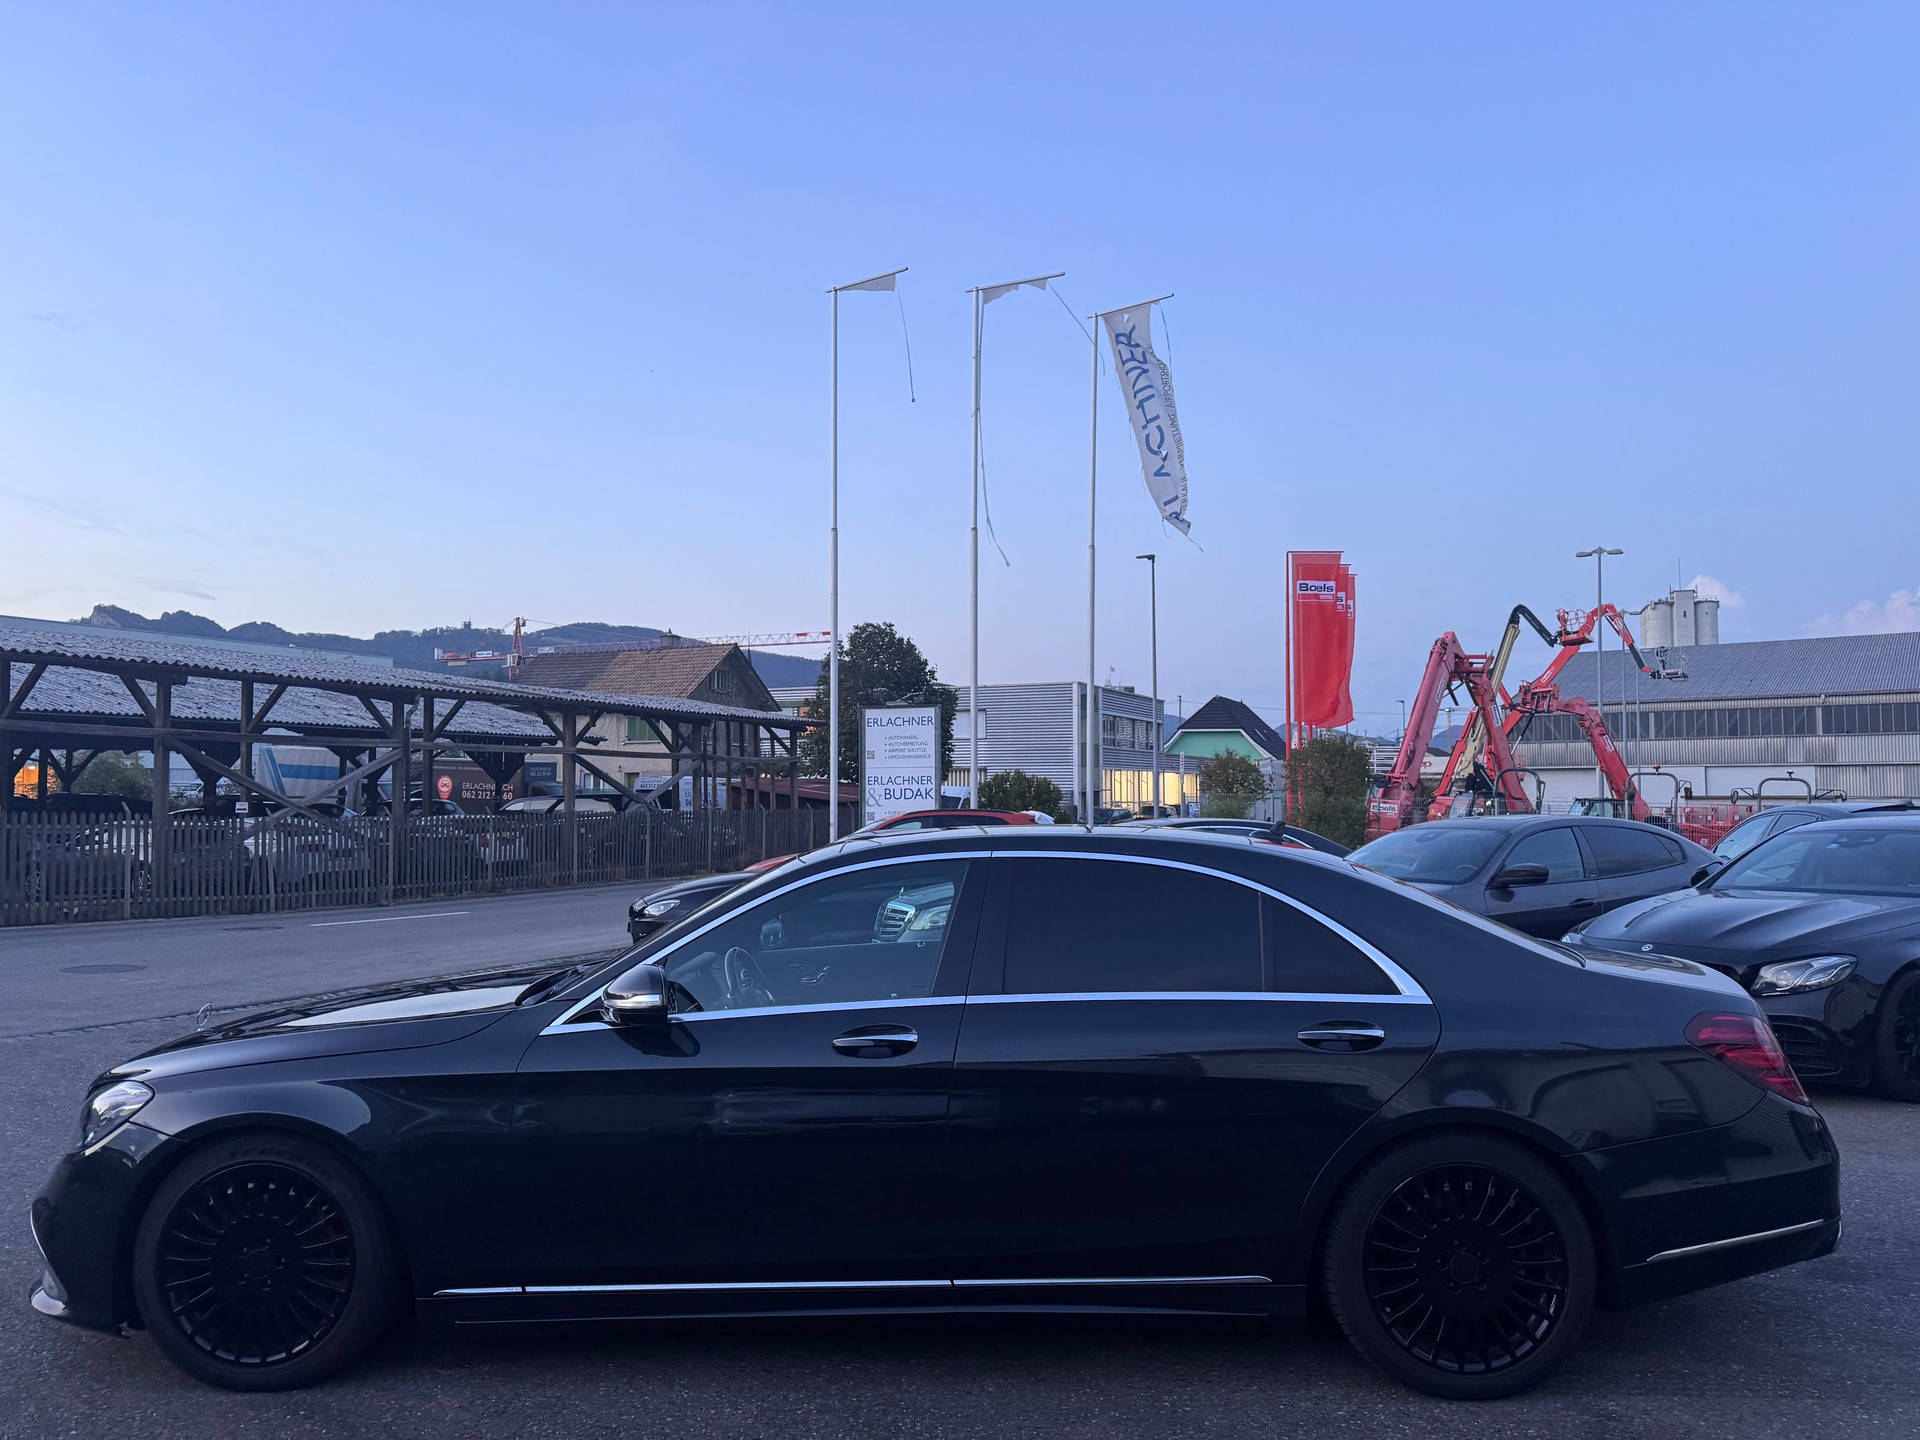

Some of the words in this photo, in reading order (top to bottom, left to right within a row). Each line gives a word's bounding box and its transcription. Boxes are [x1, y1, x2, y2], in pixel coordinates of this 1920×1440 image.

[1299, 582, 1334, 592] Boels
[866, 716, 934, 727] ERLACHNER
[867, 775, 933, 786] ERLACHNER
[462, 790, 475, 799] 062
[478, 791, 491, 799] 212
[502, 791, 513, 800] 60
[866, 788, 883, 807] &
[884, 788, 934, 800] BUDAK
